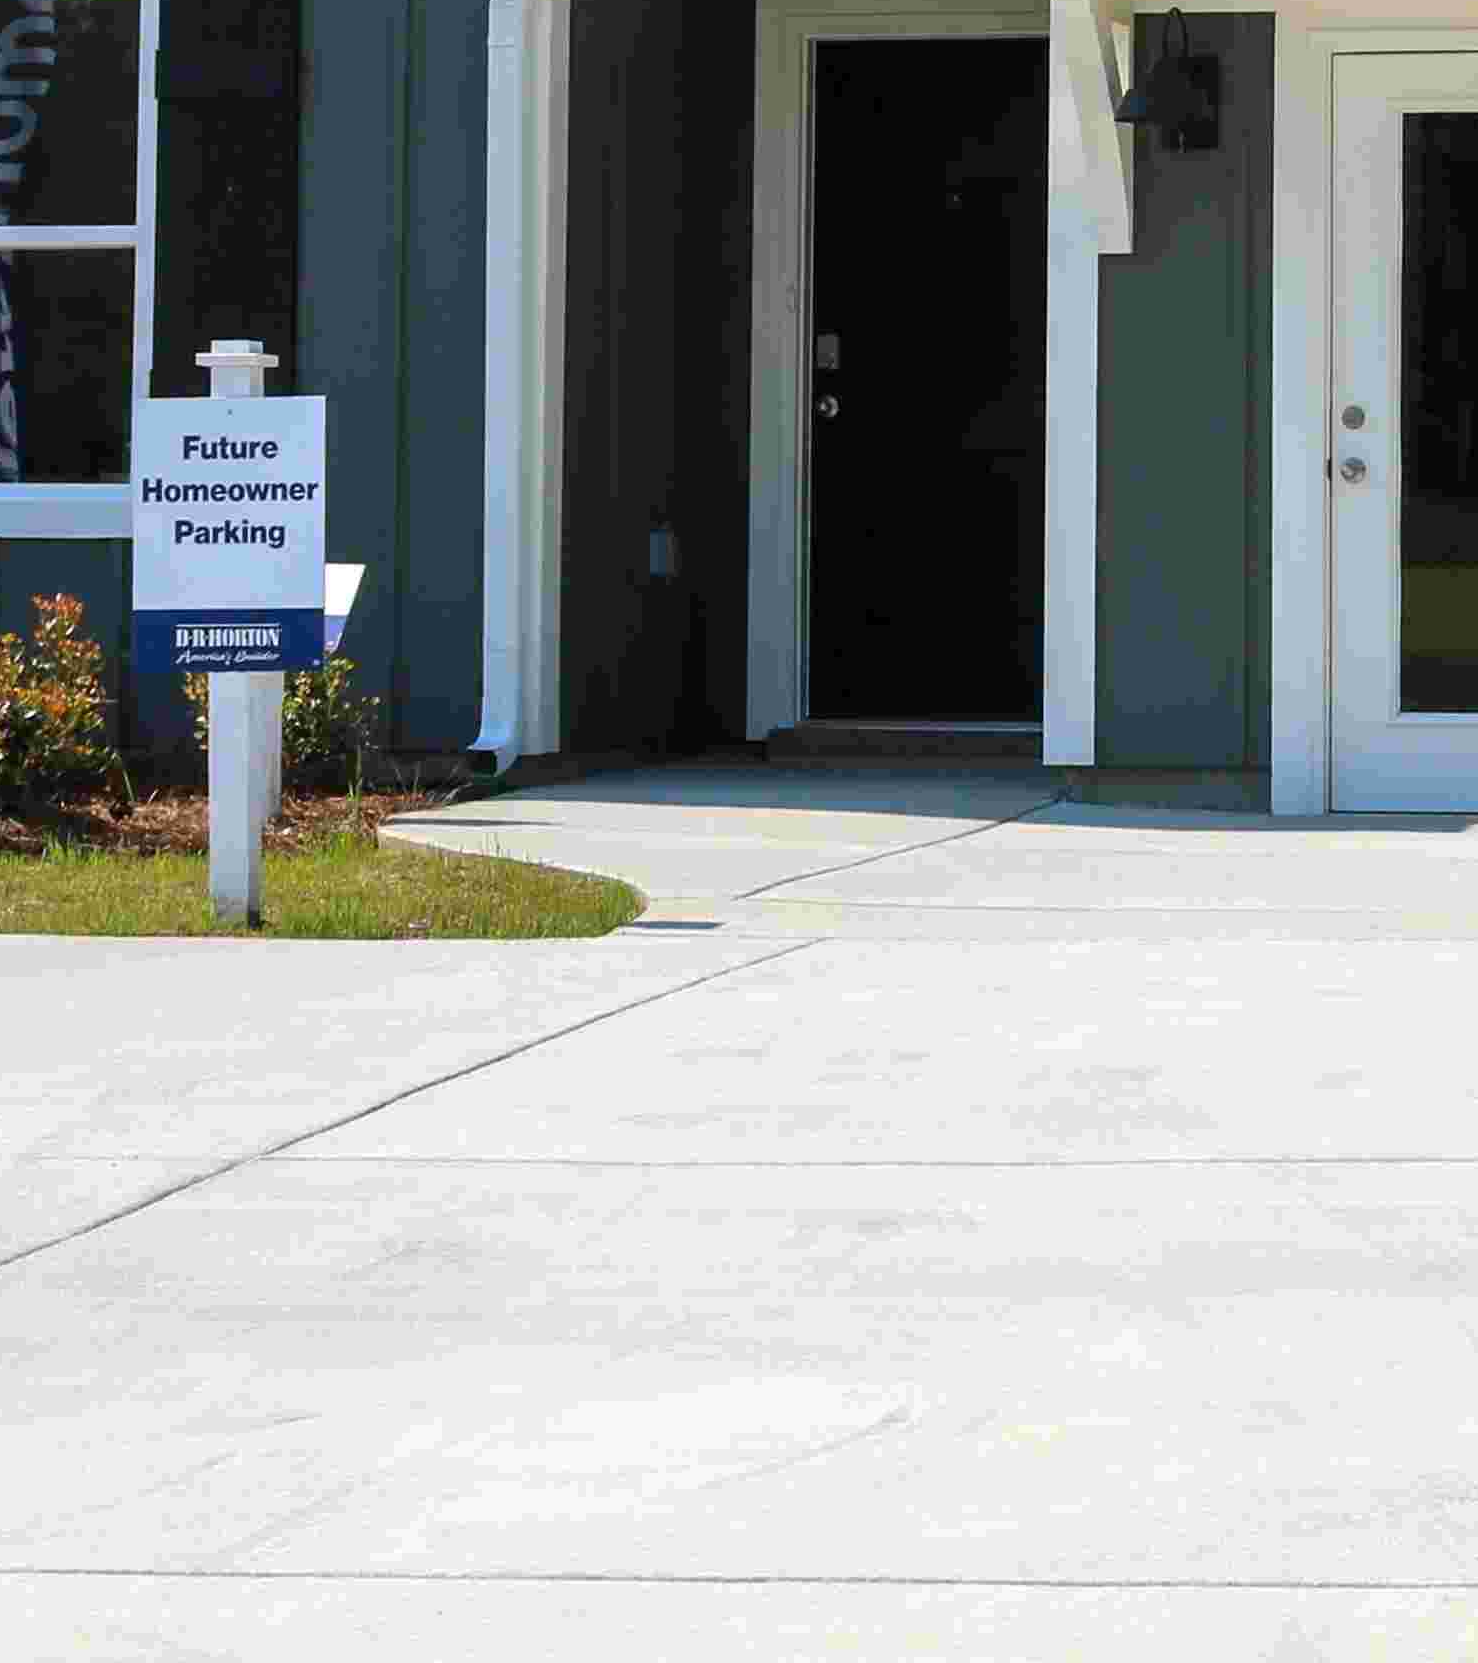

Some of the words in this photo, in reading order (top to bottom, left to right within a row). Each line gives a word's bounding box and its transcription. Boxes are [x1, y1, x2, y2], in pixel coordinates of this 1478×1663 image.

[184, 436, 278, 459] Future
[143, 478, 318, 502] Homeowner
[175, 519, 285, 549] Parking
